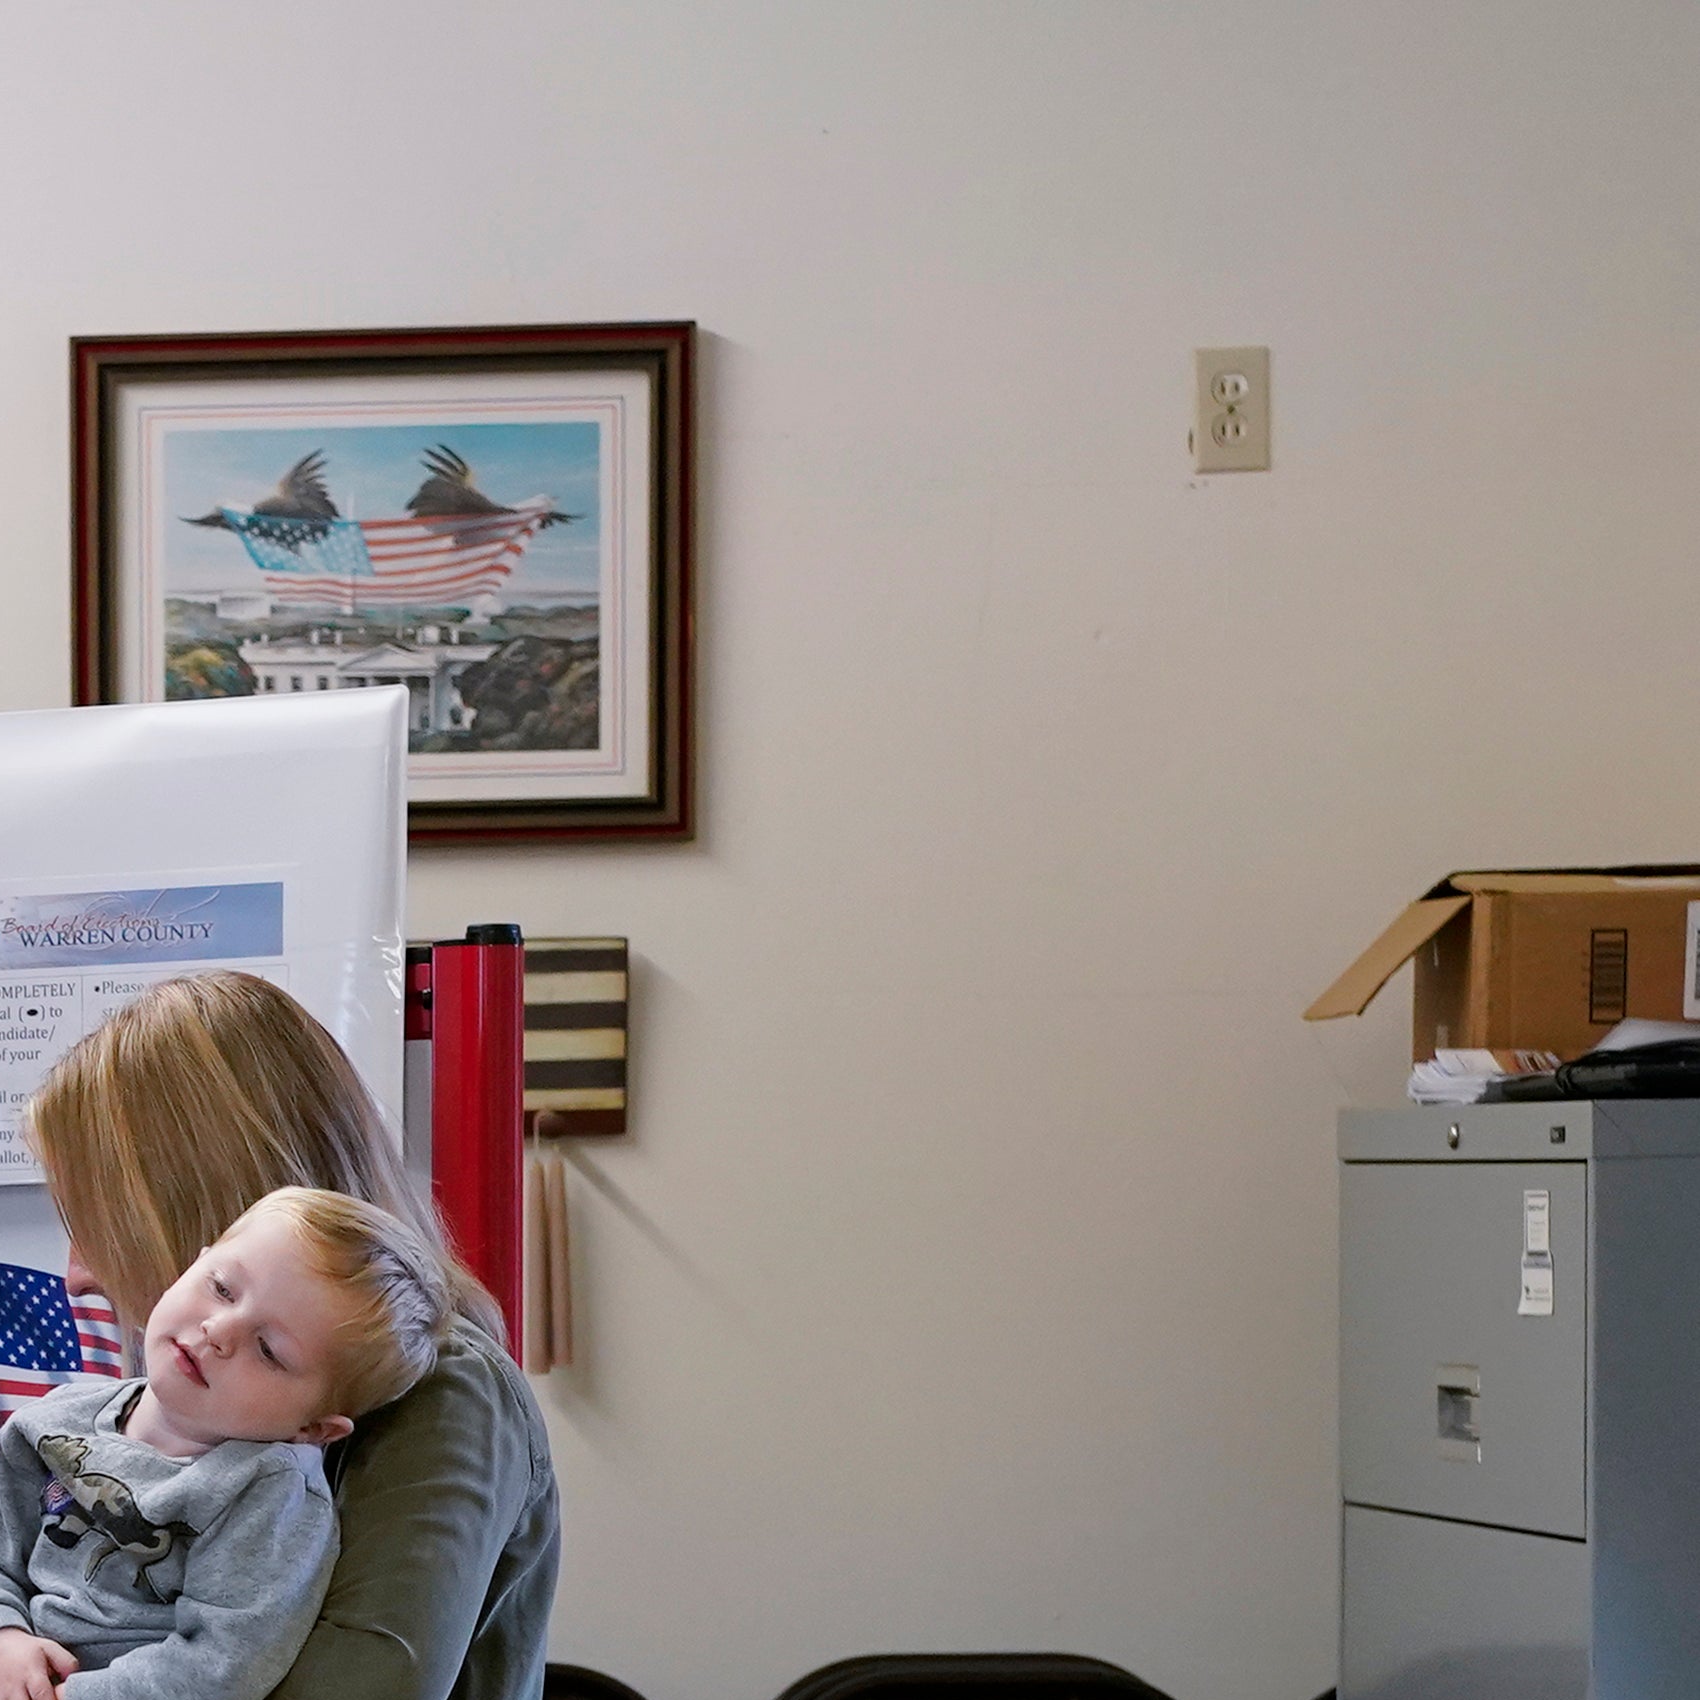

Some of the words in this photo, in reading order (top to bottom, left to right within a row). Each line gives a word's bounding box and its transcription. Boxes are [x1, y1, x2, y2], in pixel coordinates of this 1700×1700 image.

[0, 914, 57, 935] Board
[59, 914, 80, 938] of
[19, 927, 117, 949] WARREN
[121, 922, 217, 944] COUNTY
[49, 1006, 63, 1018] to
[9, 1050, 42, 1065] your
[10, 1092, 25, 1104] or
